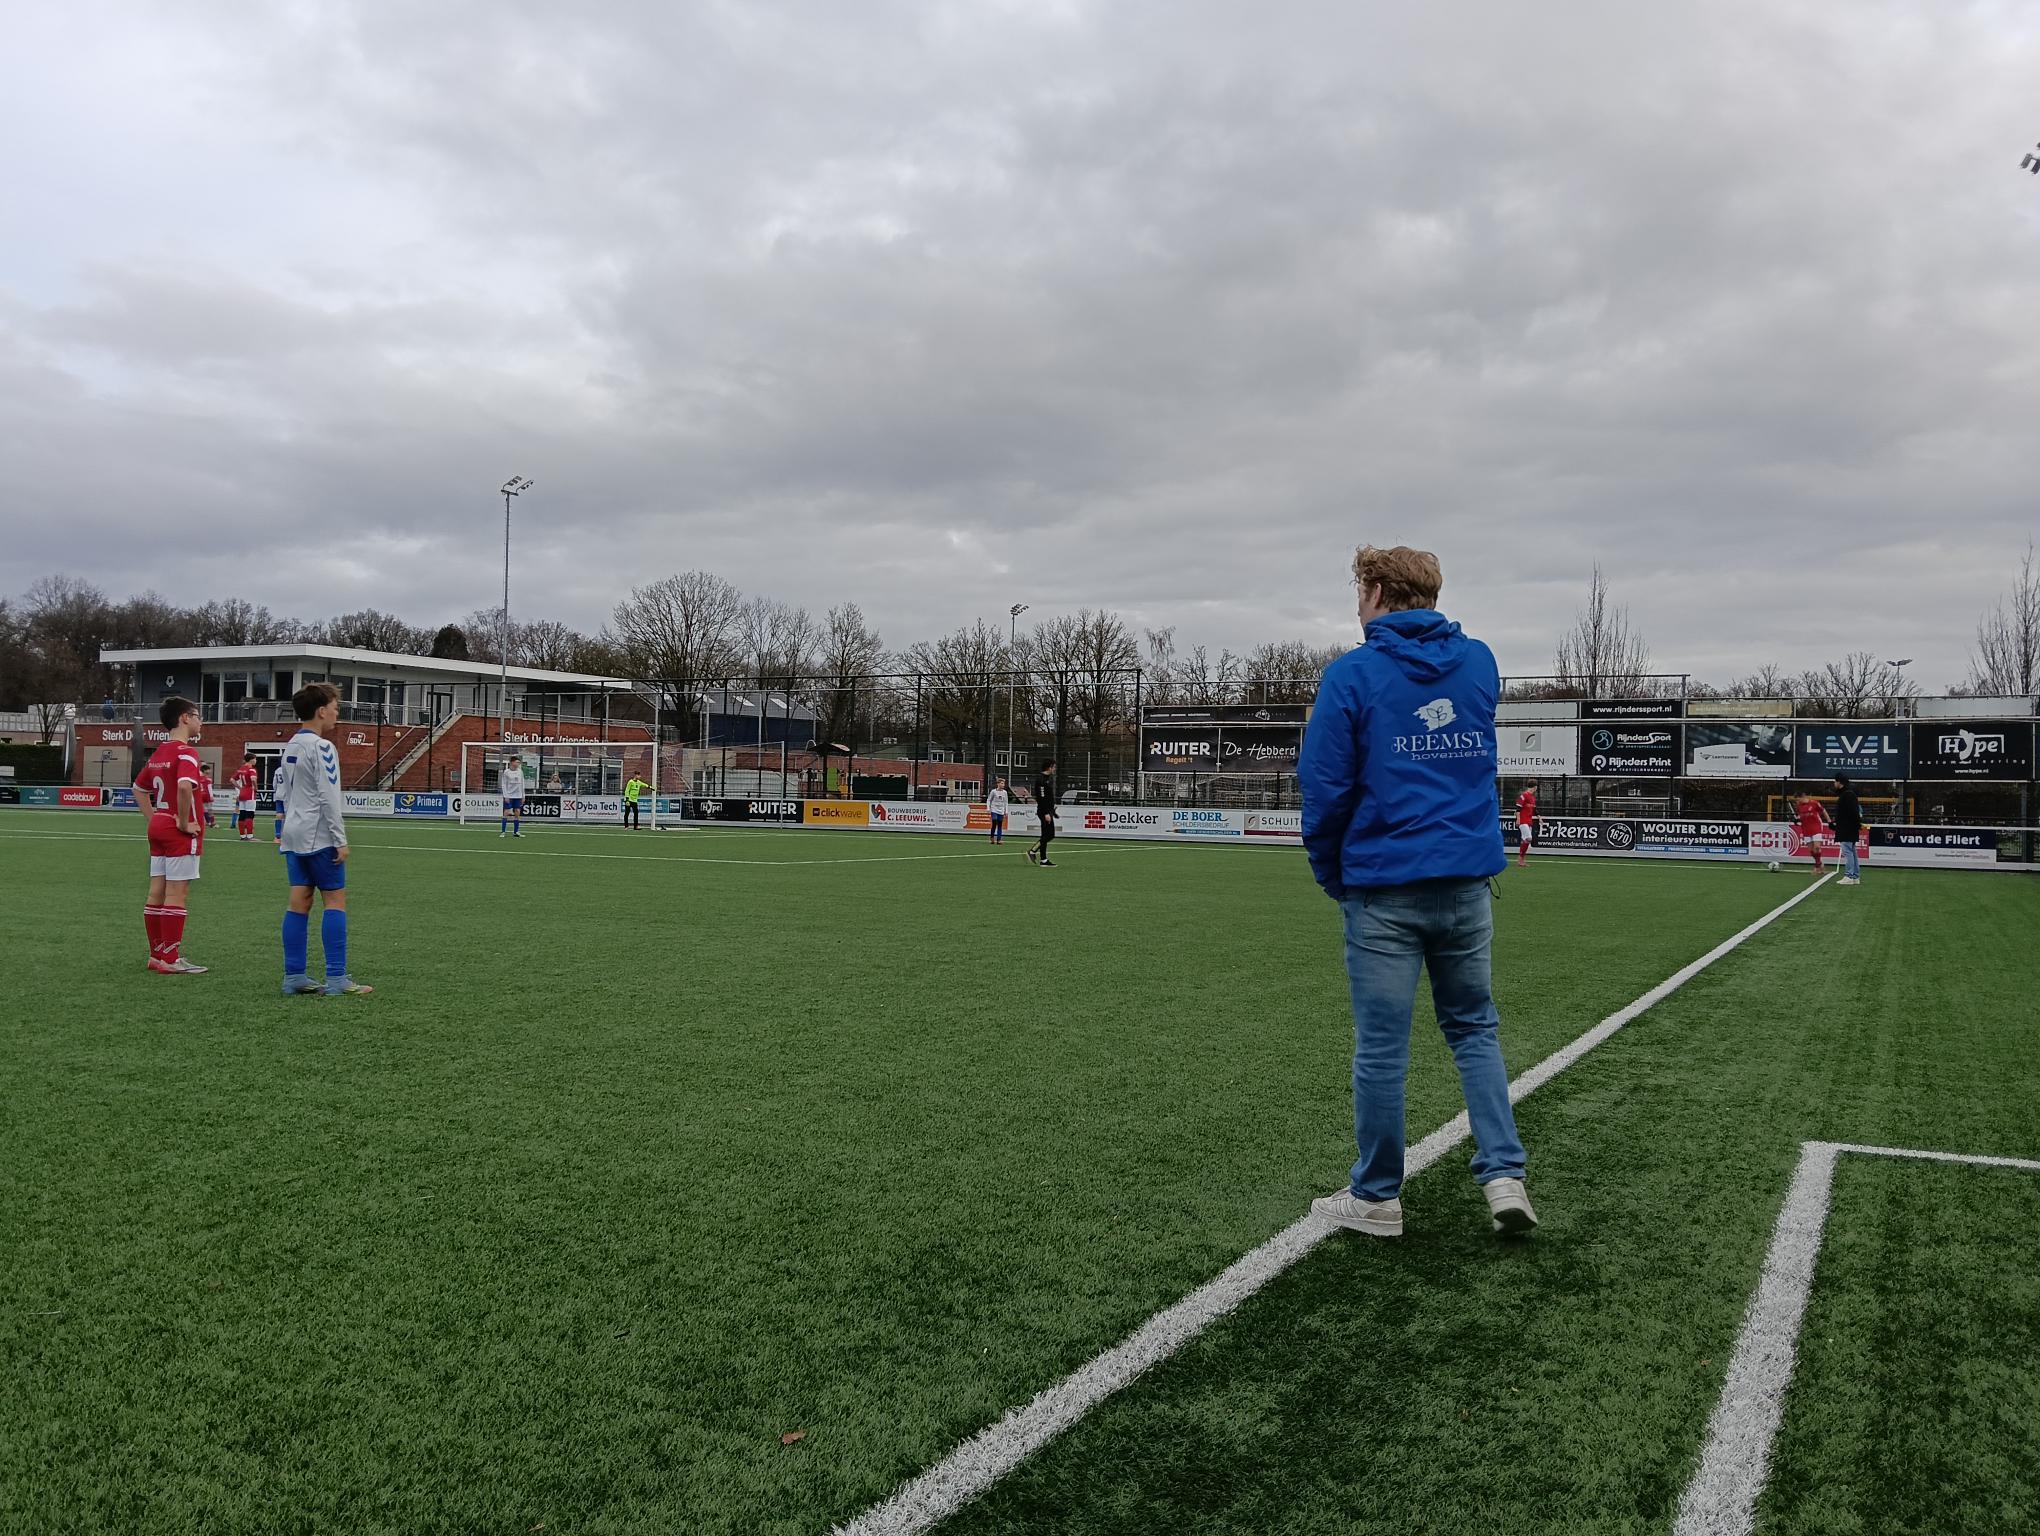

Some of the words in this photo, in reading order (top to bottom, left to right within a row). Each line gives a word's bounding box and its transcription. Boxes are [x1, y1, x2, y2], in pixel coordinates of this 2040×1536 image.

[1592, 705, 1672, 714] www.rijnderssport.nl
[102, 729, 124, 741] Sterk
[125, 729, 146, 741] Dr
[1391, 731, 1484, 753] REEMST
[1806, 735, 1898, 754] LEVEL
[1944, 729, 1999, 760] Hype
[1150, 742, 1211, 756] RUITER
[1223, 741, 1242, 756] De
[1246, 743, 1296, 760] Hebberd
[1411, 749, 1488, 761] hoveniers
[1497, 757, 1565, 766] SCHUITEMAN
[1609, 757, 1648, 768] Rijnders
[1649, 757, 1672, 767] Print
[1825, 757, 1878, 765] FITNESS
[153, 775, 170, 809] 2
[345, 795, 391, 807] Yourlease
[416, 795, 443, 807] Primera
[464, 799, 500, 807] COLLINS
[577, 801, 598, 812] Dyba
[599, 801, 618, 811] Tech
[749, 802, 797, 815] RUITER
[821, 807, 863, 819] clickwave
[895, 814, 927, 822] LEEUWIS
[1108, 811, 1159, 824] Dekker
[1172, 811, 1188, 821] DE
[1191, 811, 1222, 822] BOER
[1261, 816, 1300, 826] SCHUIT
[1538, 822, 1598, 839] Erkens
[1642, 823, 1697, 835] WOUTER
[1700, 824, 1742, 836] BOUW
[1642, 834, 1743, 846] interieursystemen.nl
[1751, 831, 1788, 848] EDH
[1899, 834, 1922, 844] van
[1926, 834, 1942, 845] de
[1945, 834, 1981, 846] Fliert
